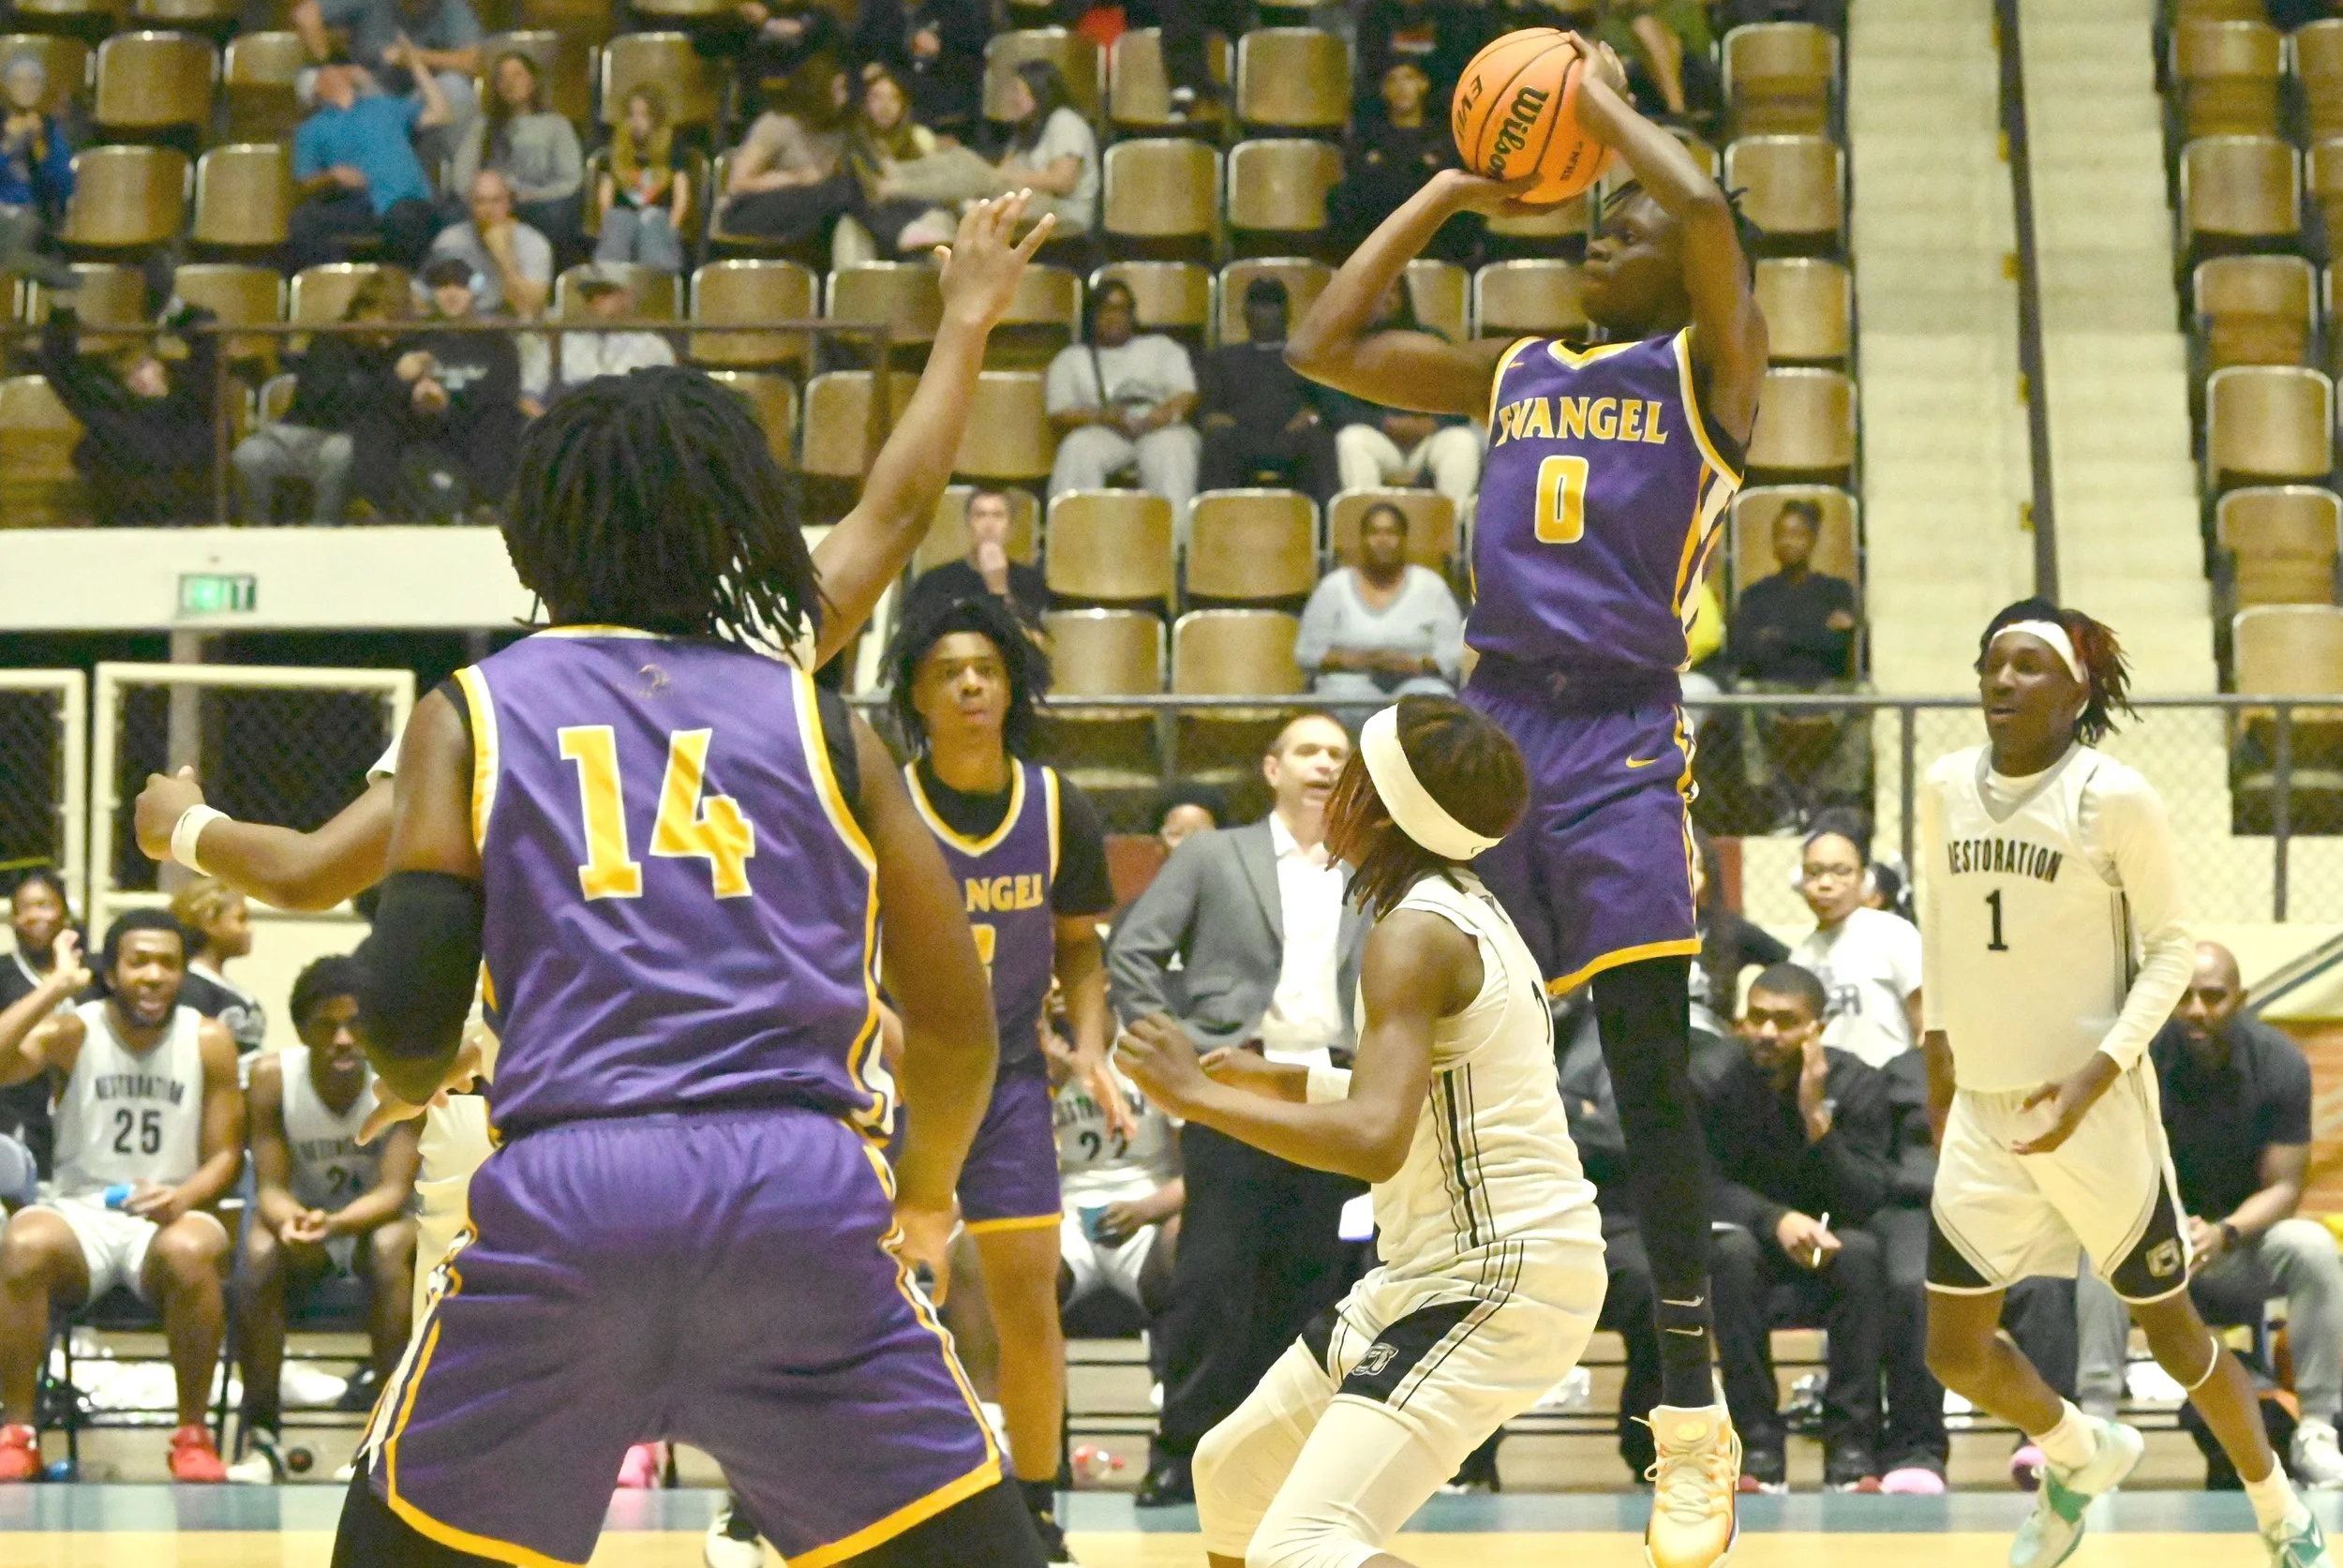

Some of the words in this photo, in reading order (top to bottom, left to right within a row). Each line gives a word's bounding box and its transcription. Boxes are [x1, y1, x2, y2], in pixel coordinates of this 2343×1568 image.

[1534, 455, 1589, 545] 0
[558, 724, 755, 901] 14
[965, 874, 1043, 912] NGEL
[1985, 889, 2008, 950] 1
[113, 1109, 161, 1154] 25
